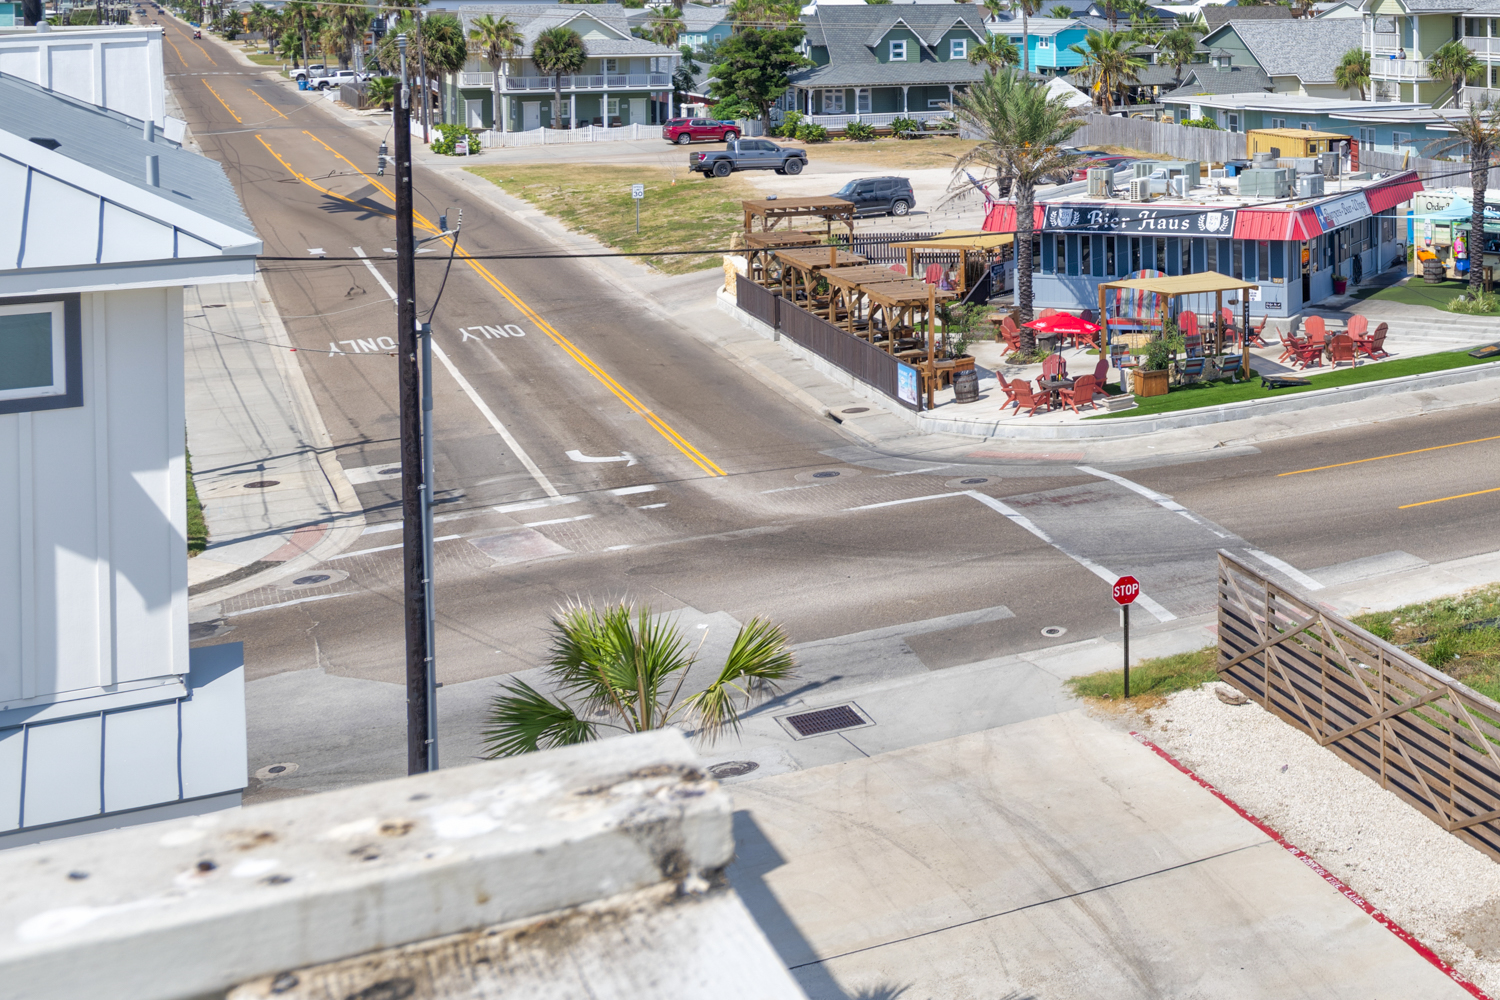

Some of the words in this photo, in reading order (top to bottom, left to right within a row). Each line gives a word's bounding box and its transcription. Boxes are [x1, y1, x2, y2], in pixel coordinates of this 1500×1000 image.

[1087, 210, 1131, 229] Bier
[1138, 210, 1190, 231] Haus
[459, 324, 526, 342] ONLY
[328, 336, 398, 357] ONLY
[1114, 583, 1139, 597] STOP
